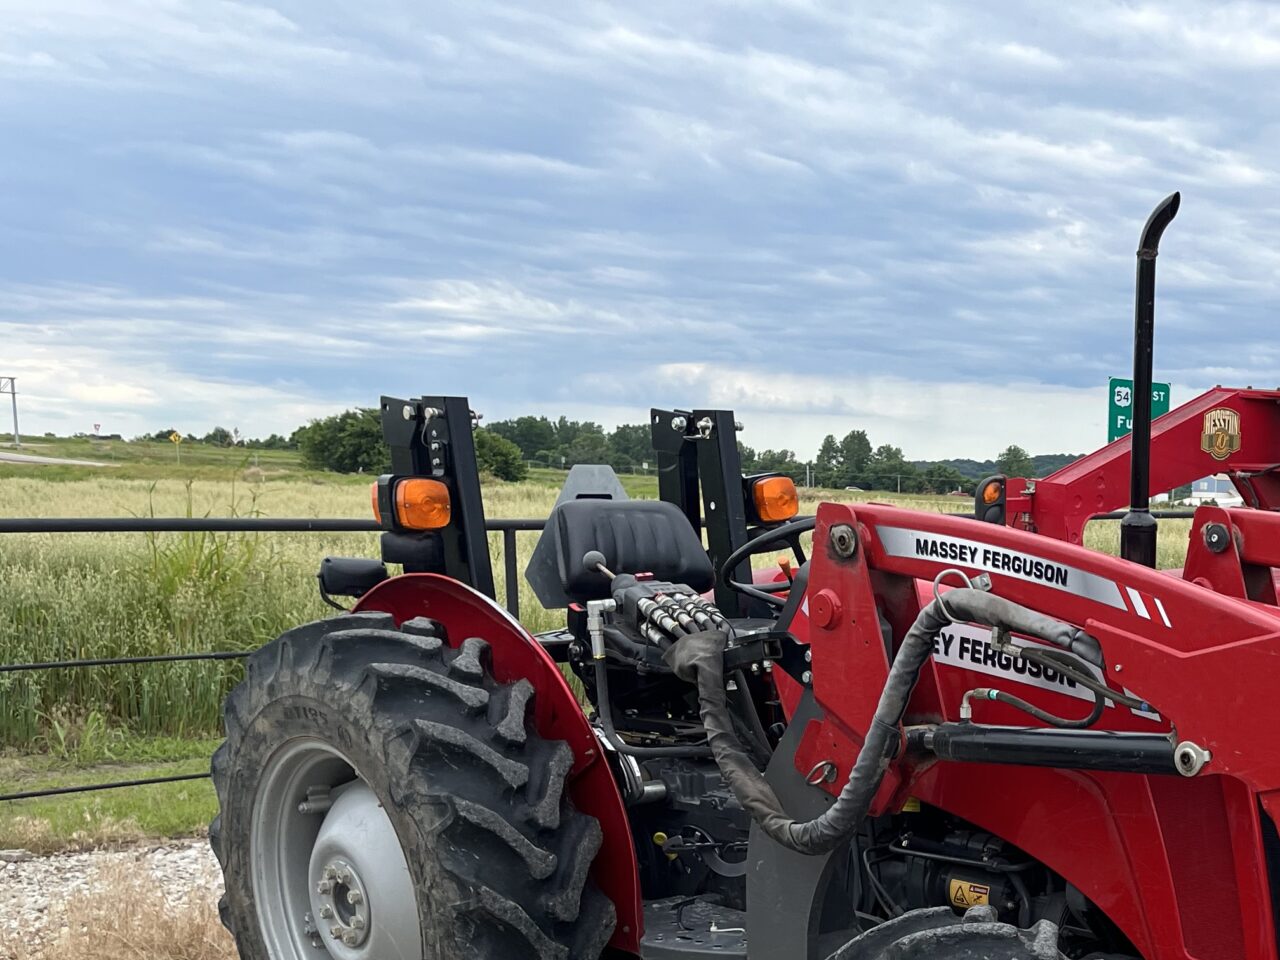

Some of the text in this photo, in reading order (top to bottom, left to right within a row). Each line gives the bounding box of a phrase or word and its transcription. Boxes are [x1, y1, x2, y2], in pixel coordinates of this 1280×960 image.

[1116, 391, 1166, 402] 54 ST
[915, 538, 1069, 587] MASSEY FERGUSON
